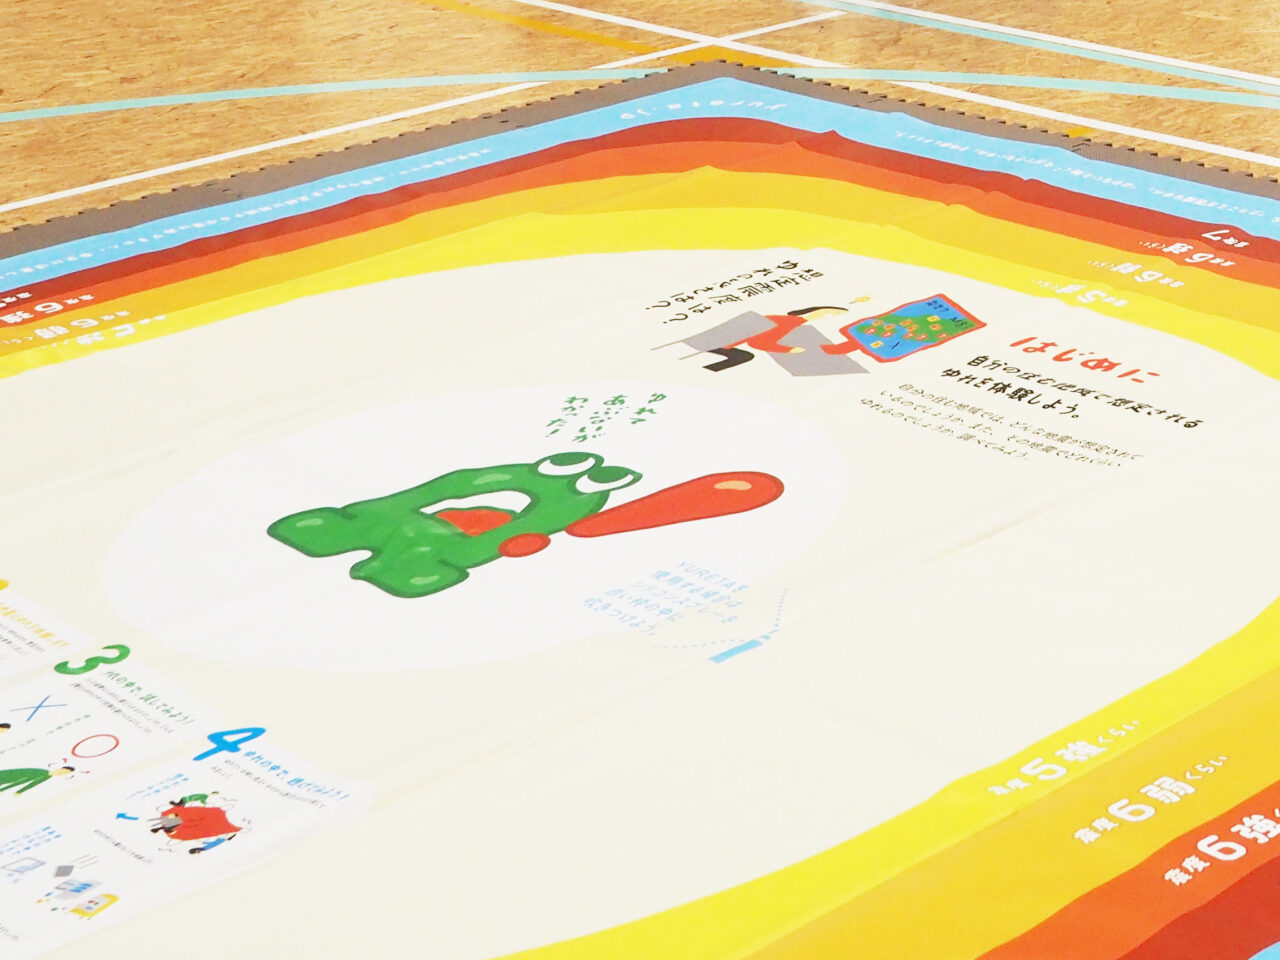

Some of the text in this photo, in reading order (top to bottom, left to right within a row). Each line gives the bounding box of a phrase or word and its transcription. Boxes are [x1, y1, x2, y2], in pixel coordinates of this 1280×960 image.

[1009, 337, 1161, 383] はじめに
[941, 368, 1079, 419] ゆれを体験しよう。
[967, 355, 1204, 429] 自分の住む地域で想定される
[54, 644, 131, 675] 3
[193, 727, 267, 762] 4
[986, 720, 1140, 796] 震度5強くらい
[1073, 755, 1228, 845] 震度6弱くらい
